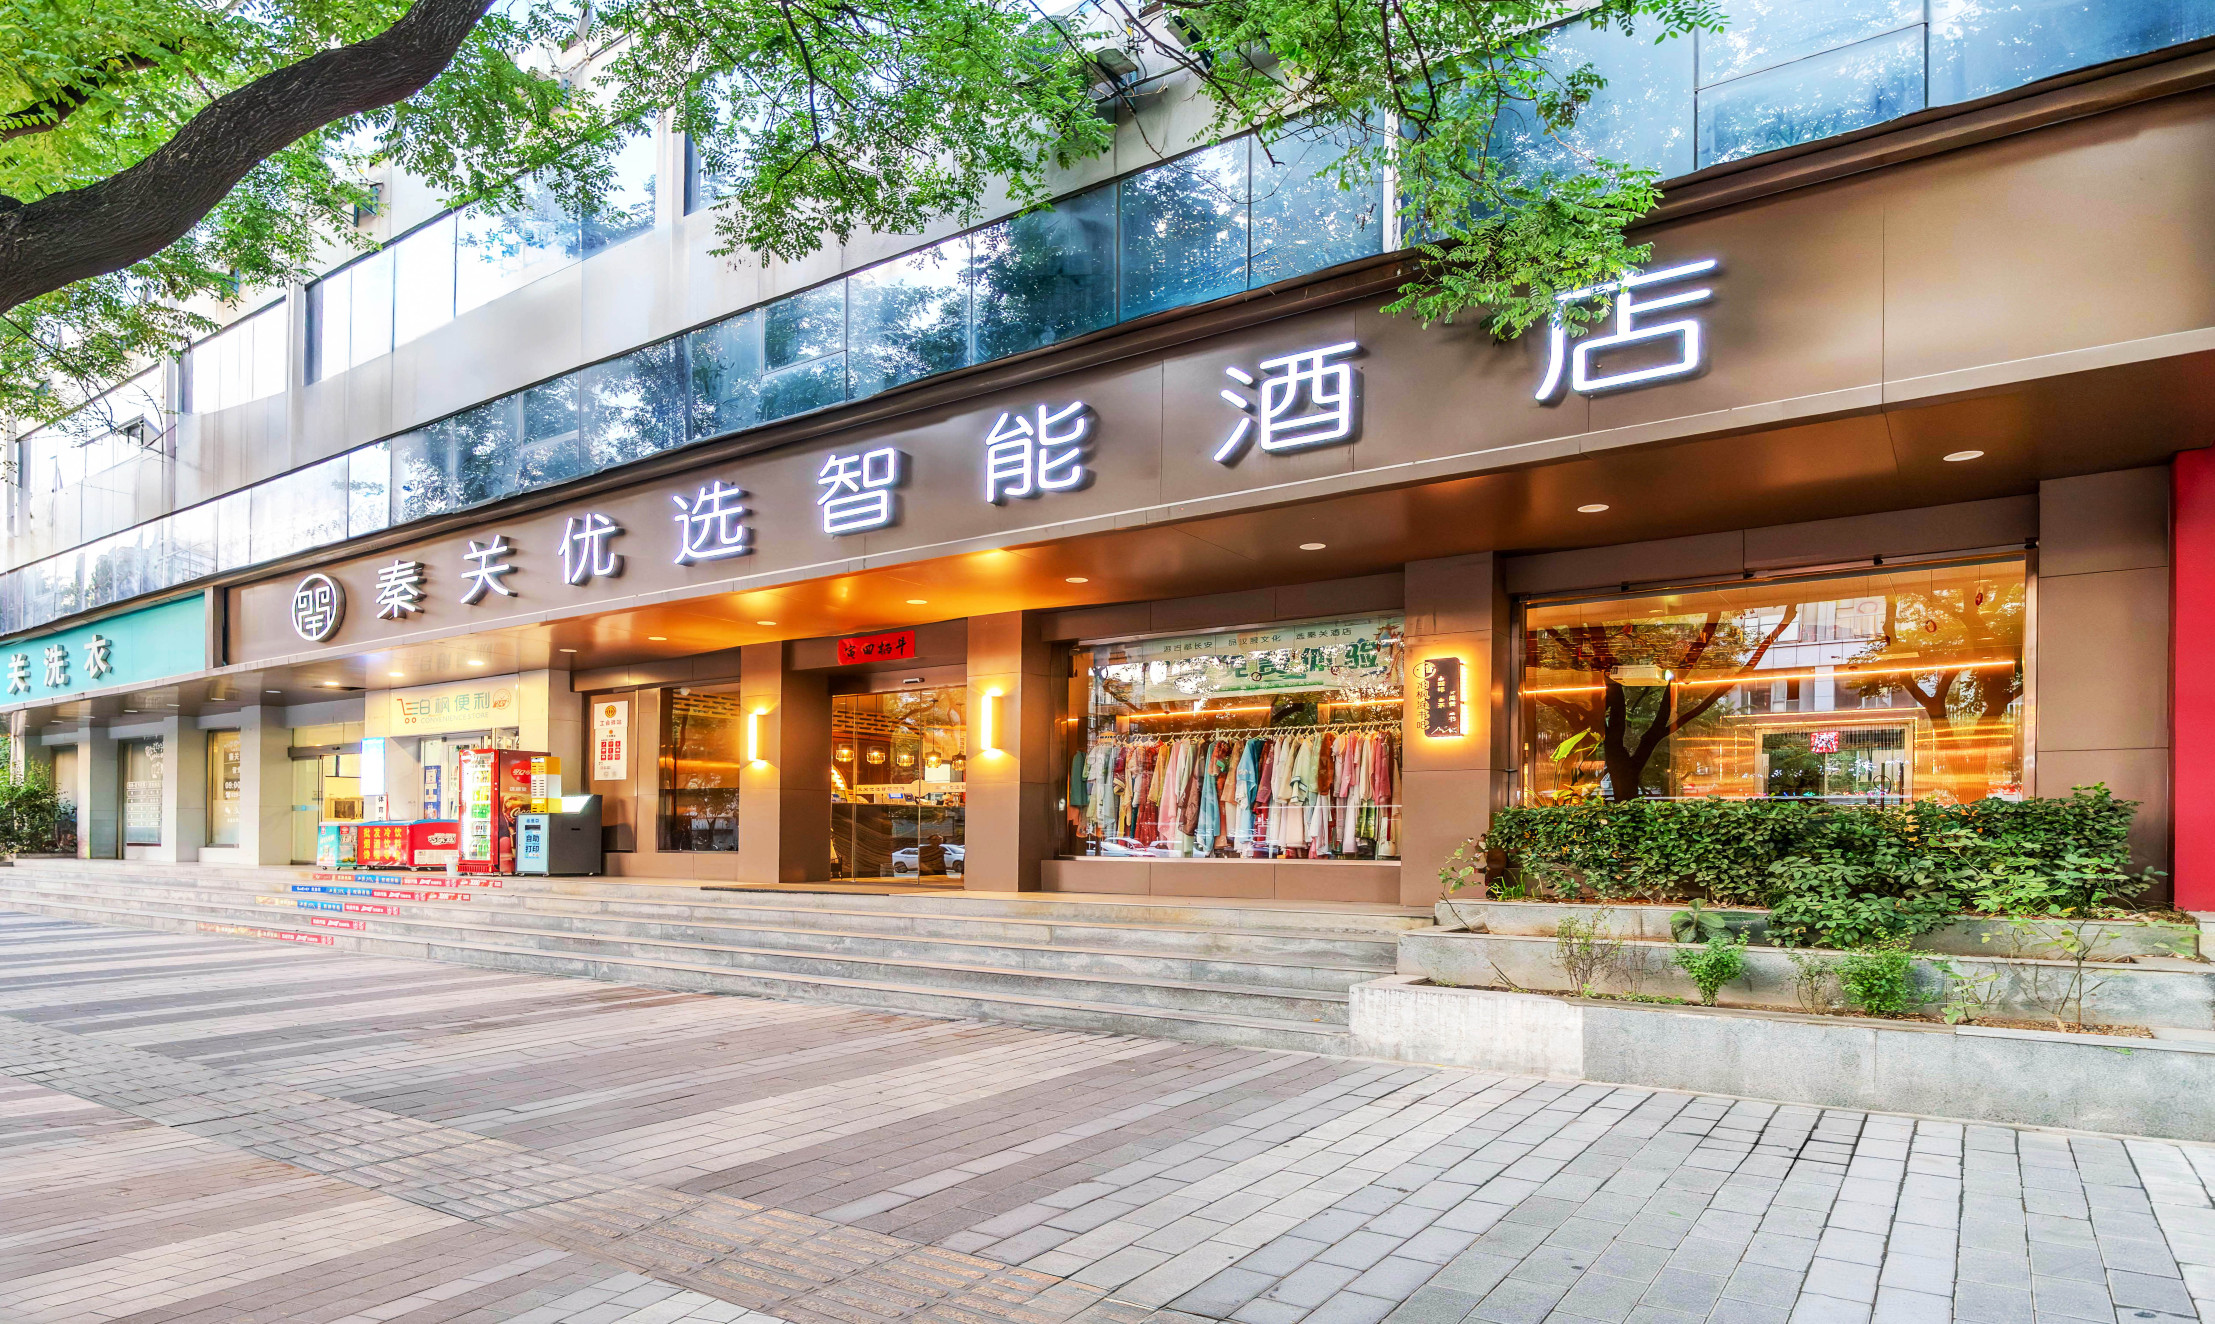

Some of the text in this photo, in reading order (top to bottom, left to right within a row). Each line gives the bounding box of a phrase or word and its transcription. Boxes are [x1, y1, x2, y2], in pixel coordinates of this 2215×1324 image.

[375, 259, 1718, 621] 秦关优选智能酒店
[7, 634, 112, 695] 关洗衣
[525, 845, 540, 853] 打印
[526, 834, 540, 843] 自助
